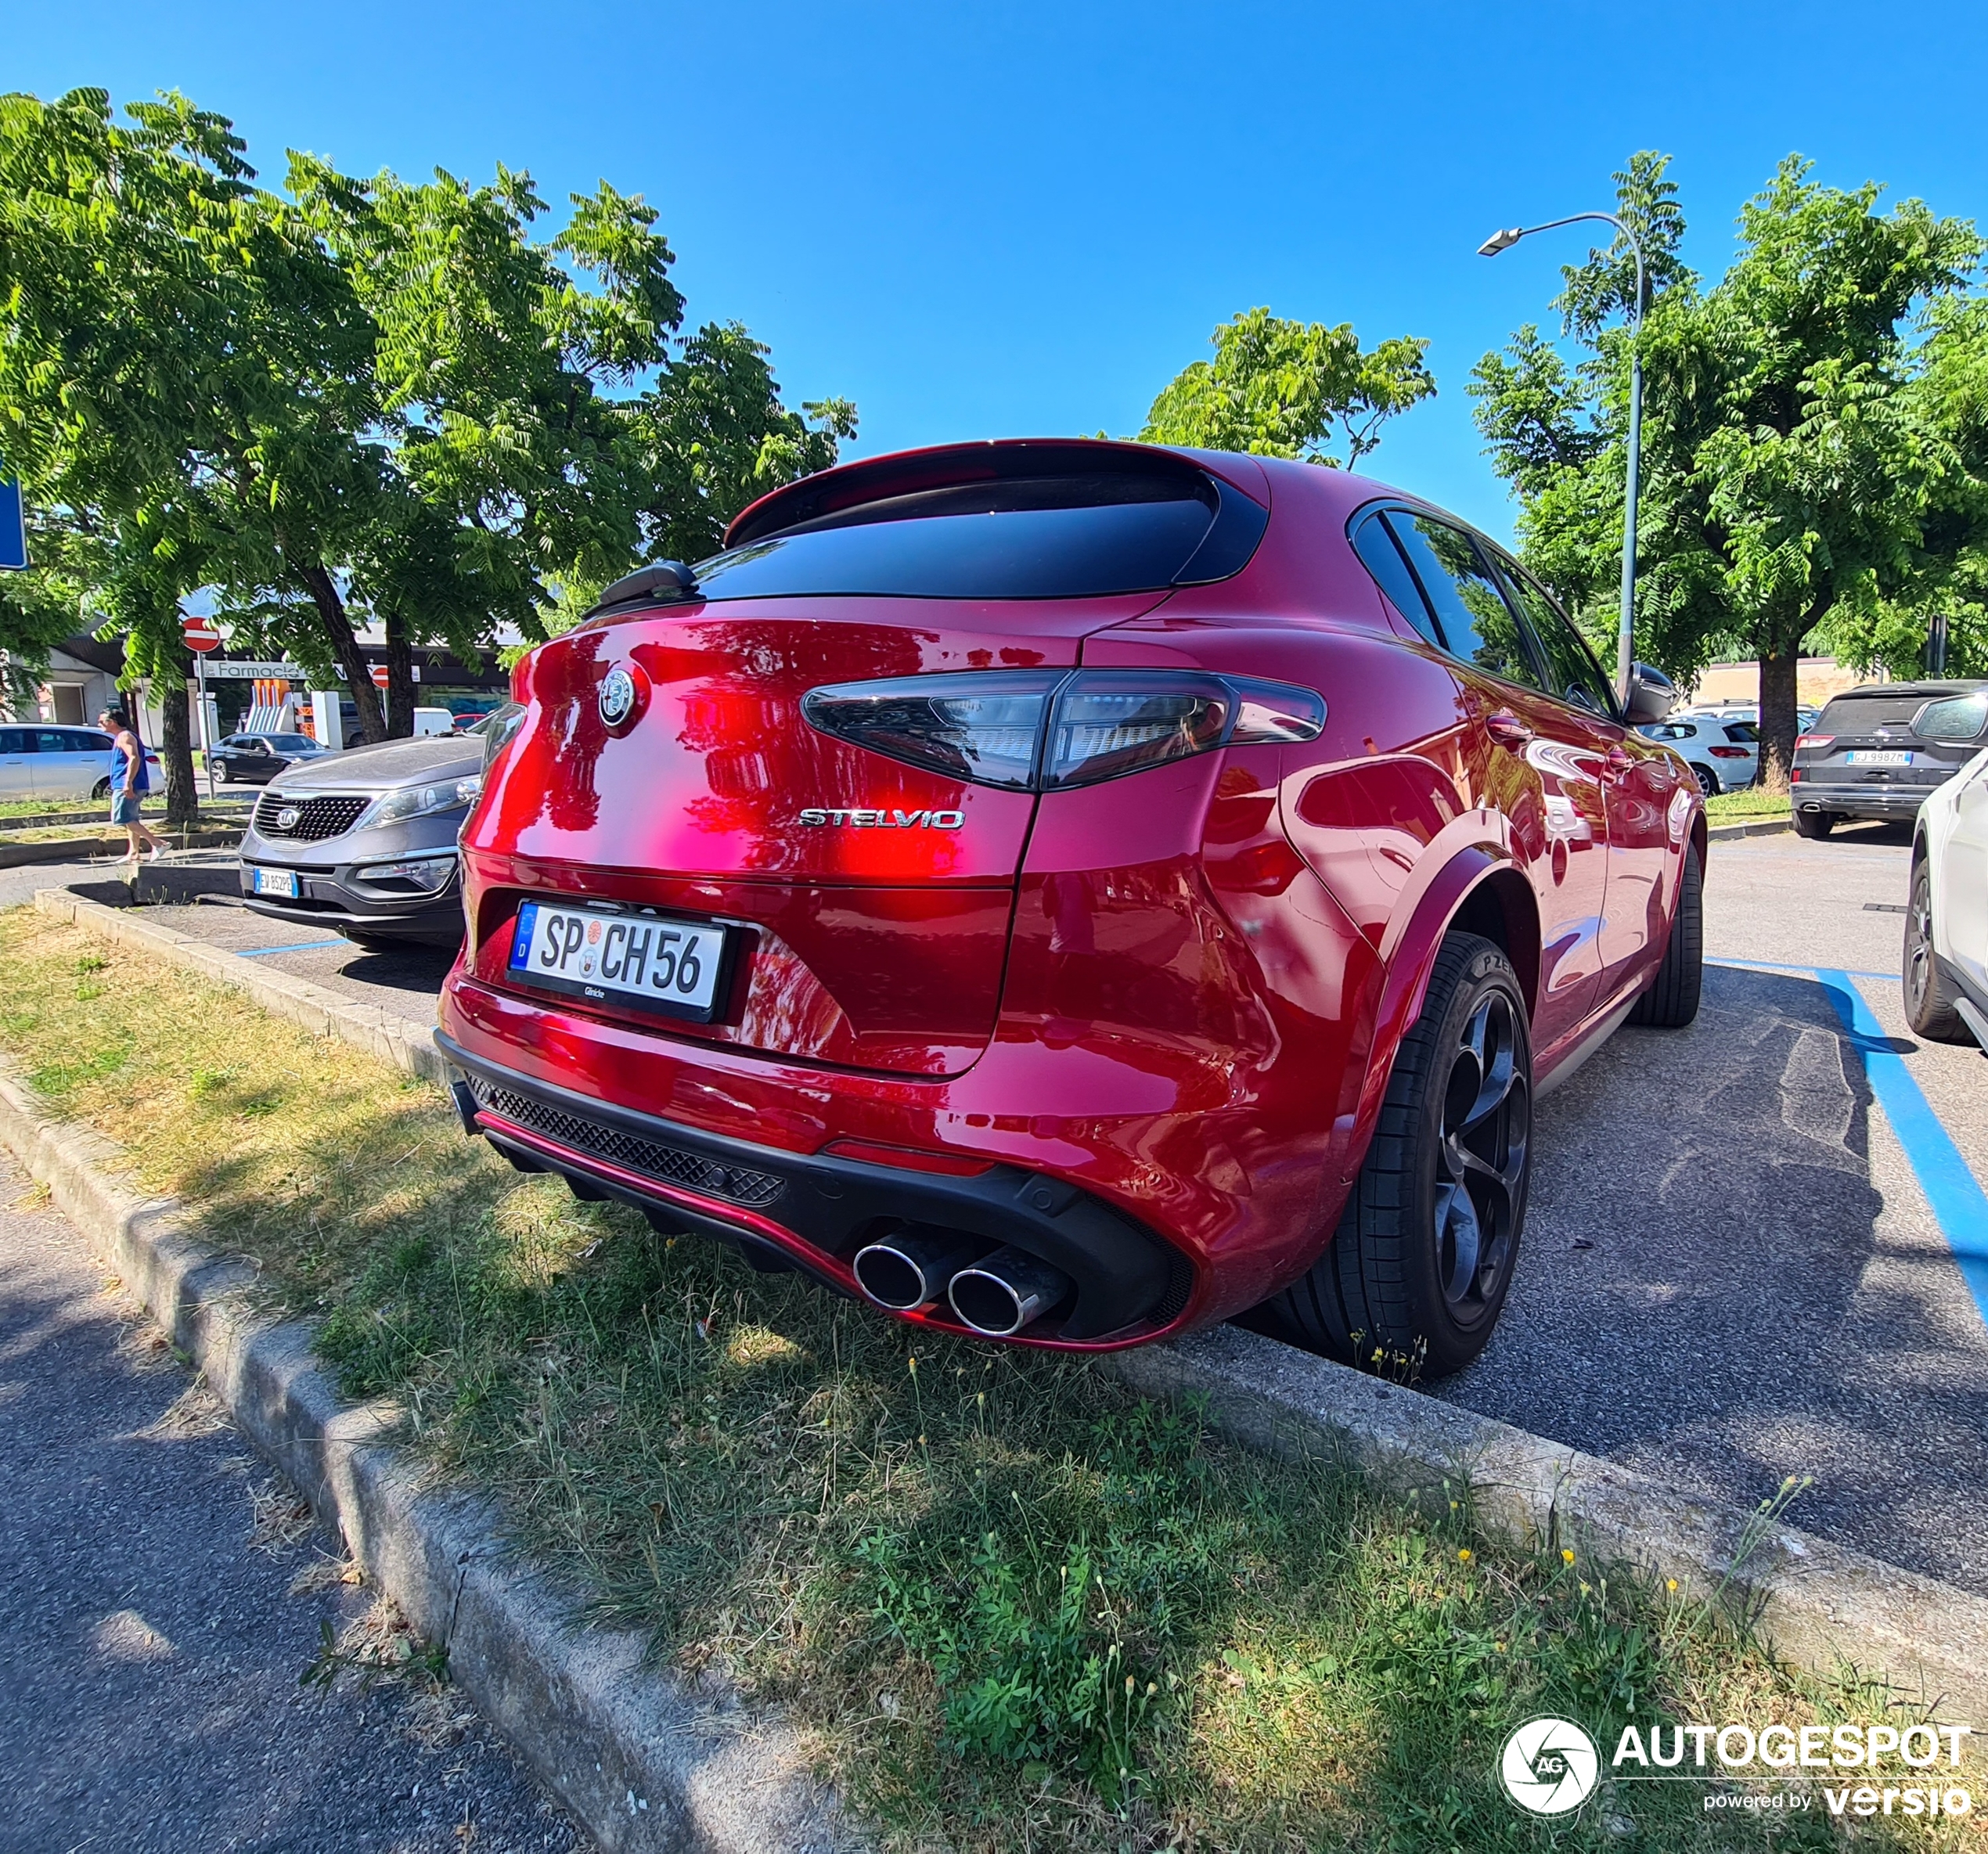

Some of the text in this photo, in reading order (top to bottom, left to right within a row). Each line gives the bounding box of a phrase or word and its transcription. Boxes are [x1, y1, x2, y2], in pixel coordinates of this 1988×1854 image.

[218, 662, 299, 678] Farmacia
[799, 808, 966, 829] STELVIO
[517, 943, 526, 958] D
[541, 915, 584, 970] SP
